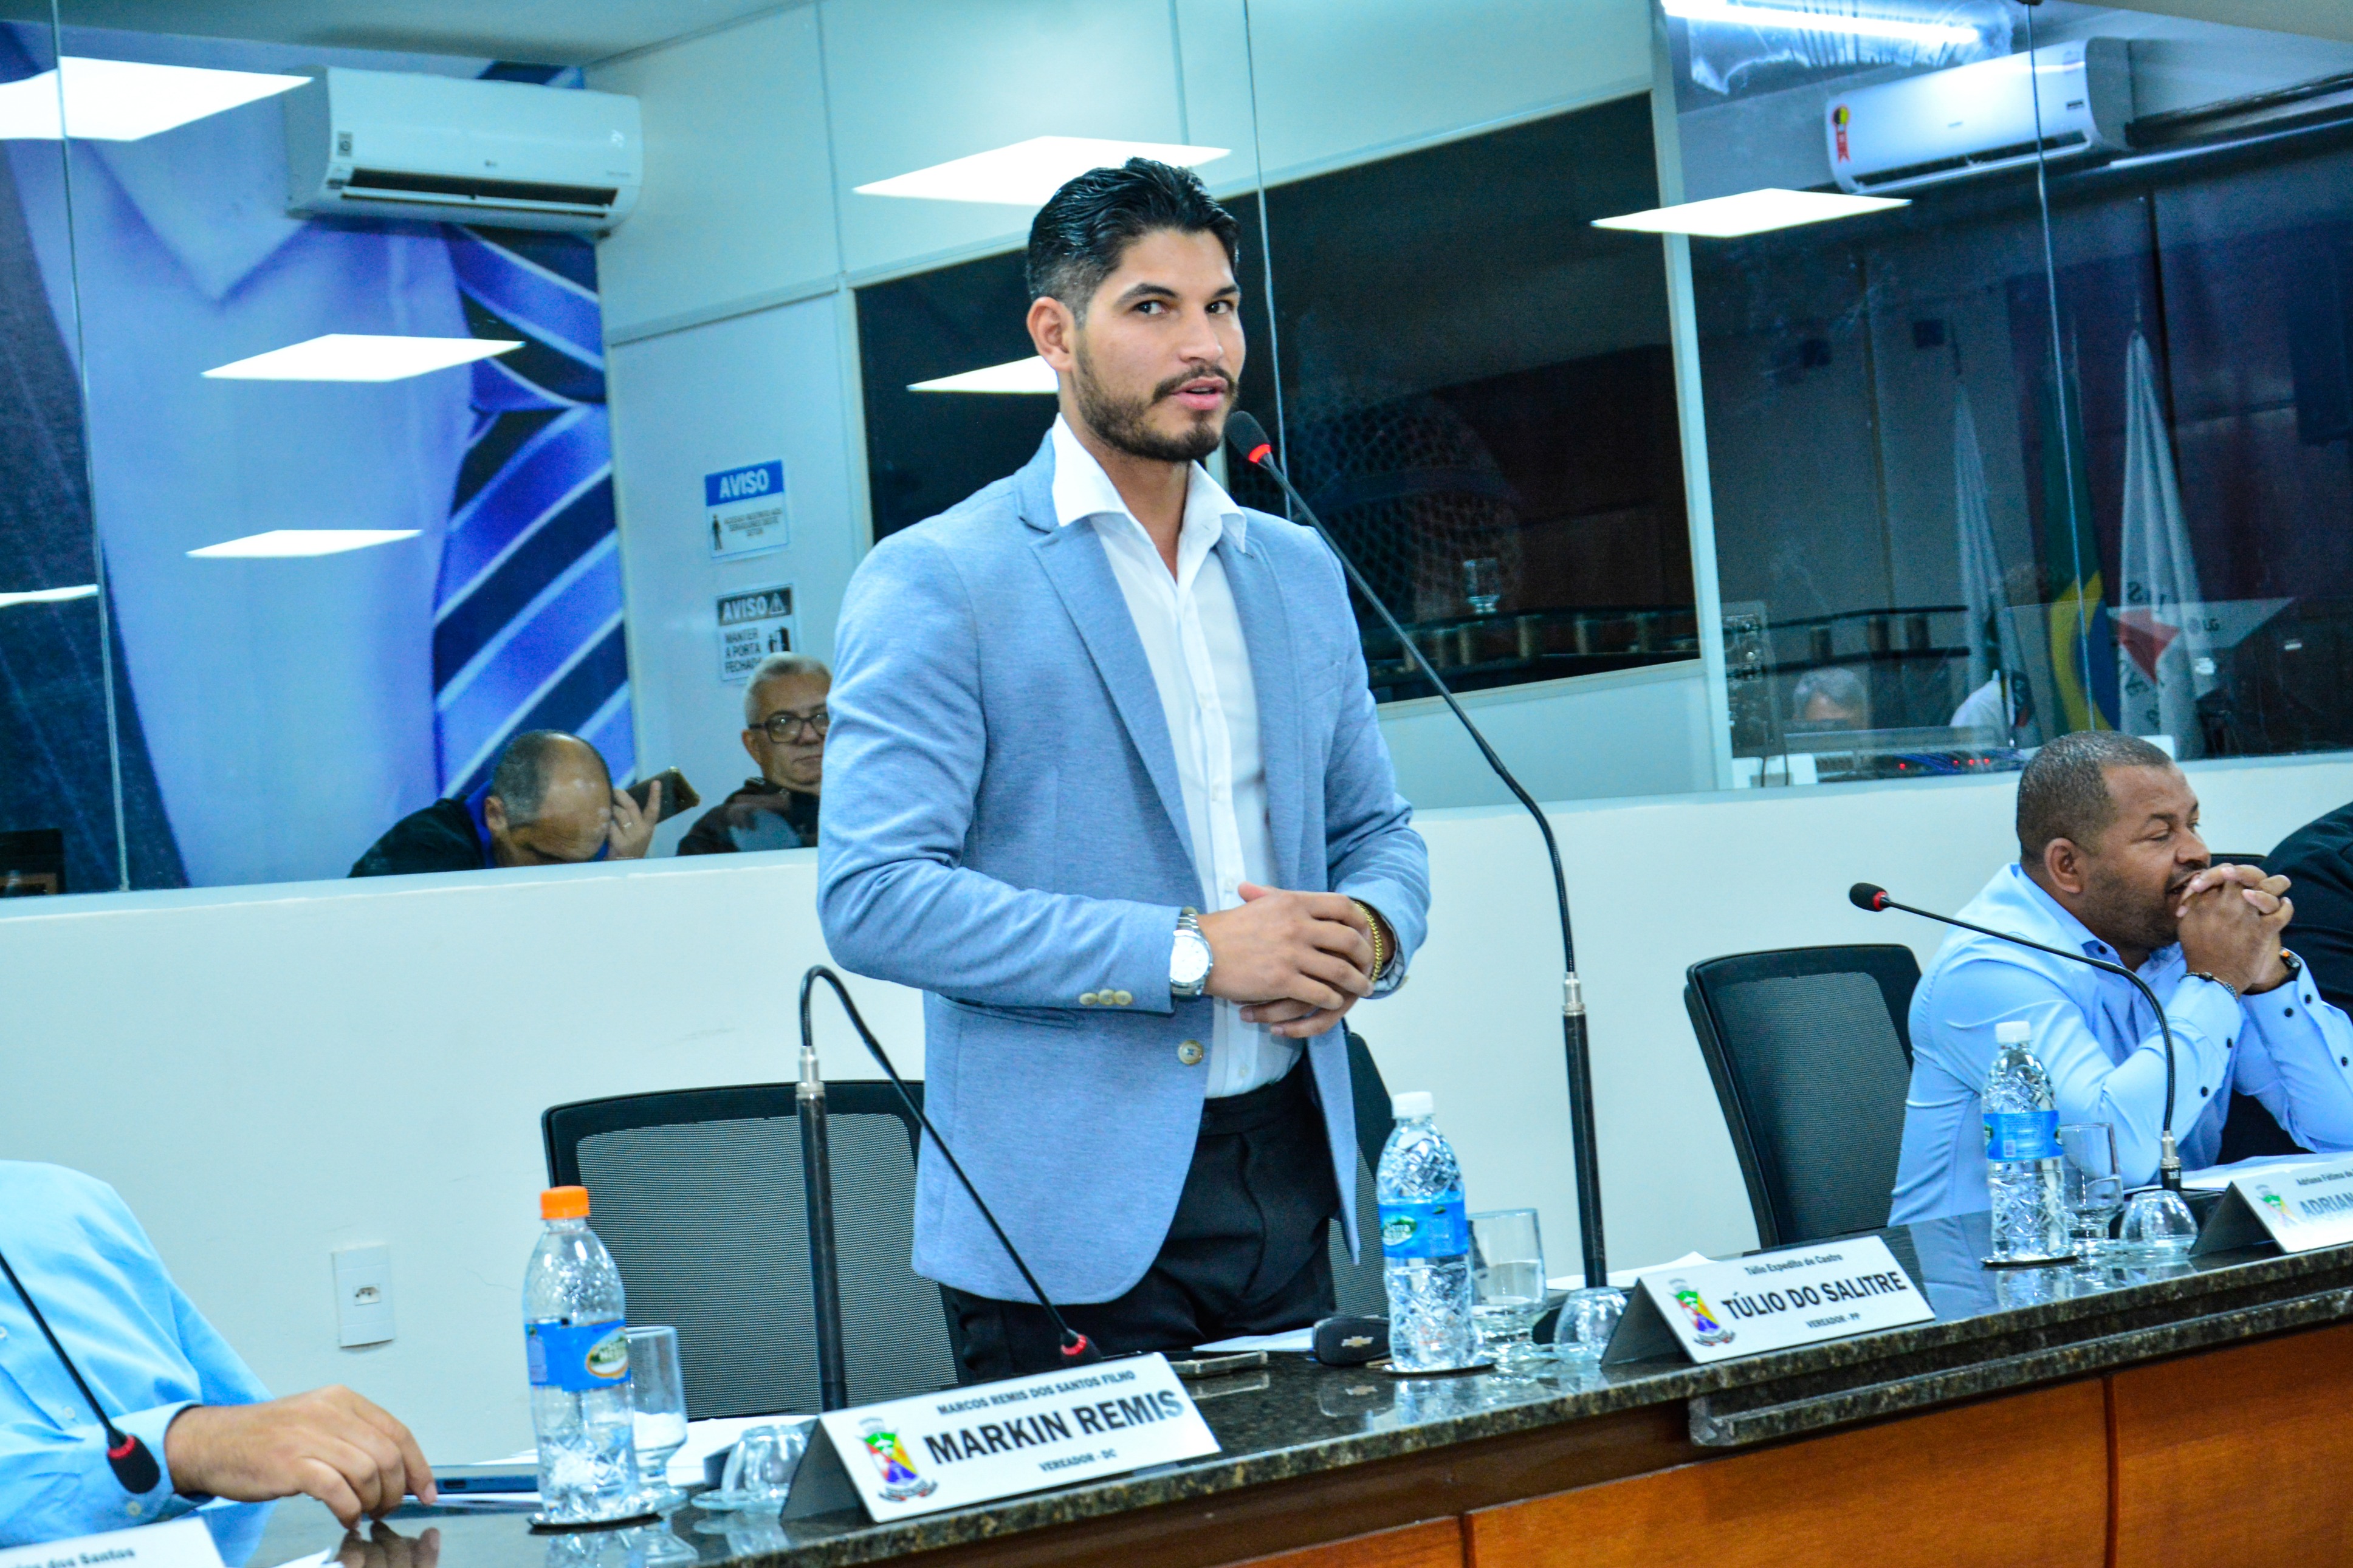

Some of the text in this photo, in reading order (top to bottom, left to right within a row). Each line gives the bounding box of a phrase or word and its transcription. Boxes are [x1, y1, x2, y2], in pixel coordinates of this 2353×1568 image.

[719, 468, 769, 500] AVISO
[723, 596, 767, 623] AVISO
[726, 642, 761, 658] A PORTA
[1766, 1259, 1804, 1272] Expedito
[1815, 1254, 1843, 1264] Castro
[1721, 1270, 1908, 1320] TÚLIO DO SALITRE
[1805, 1315, 1847, 1328] VEREADOR
[1849, 1312, 1861, 1321] PP
[937, 1370, 1136, 1416] MARCOS REMIS DOS SANTOS FILHO
[922, 1389, 1185, 1465] MARKIN REMIS
[1039, 1453, 1096, 1471] VEREADOR
[78, 1548, 136, 1566] Santos
